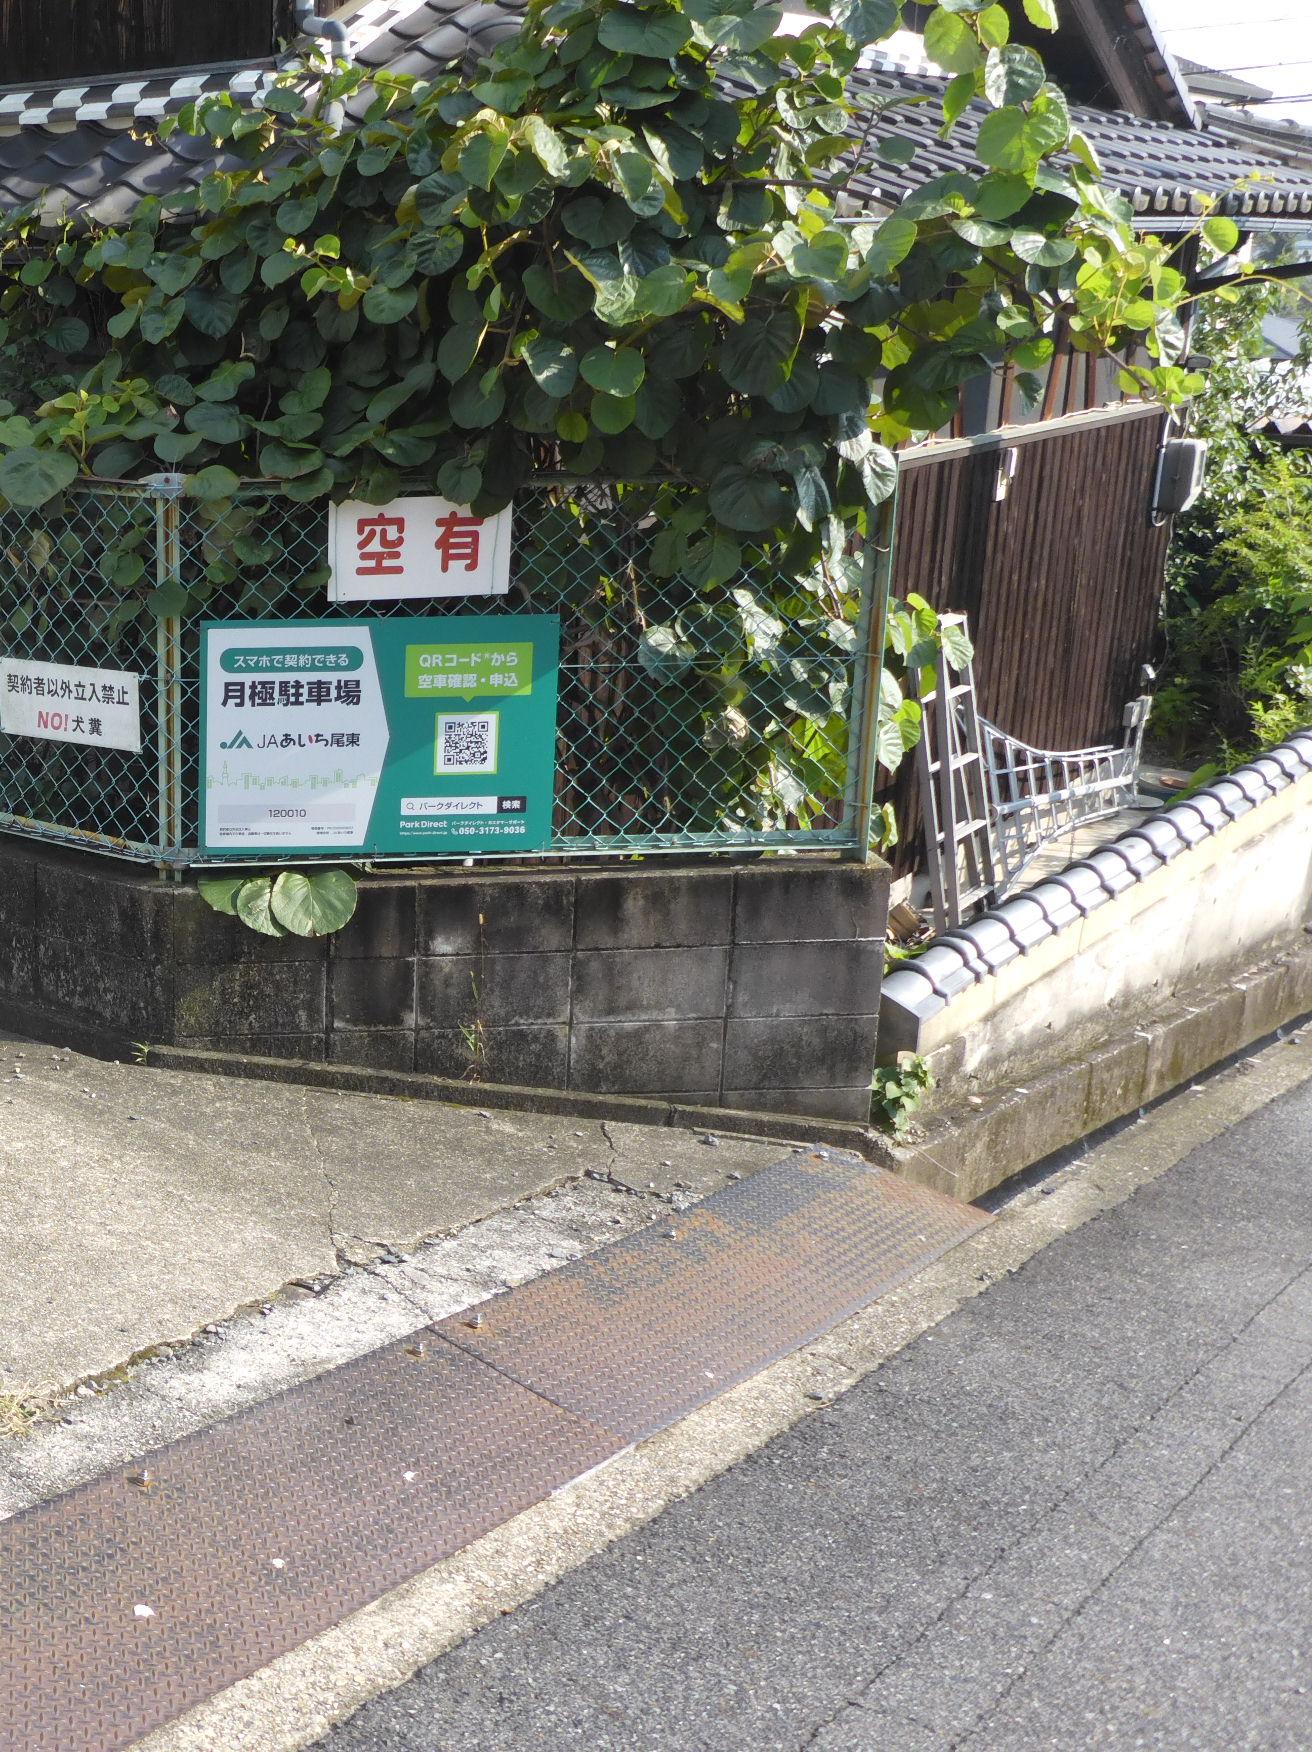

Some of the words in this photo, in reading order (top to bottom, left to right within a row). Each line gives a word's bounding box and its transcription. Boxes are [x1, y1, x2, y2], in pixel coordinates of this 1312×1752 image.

[233, 654, 349, 668] スマホで契約できる
[417, 673, 519, 689] 空車確認・申込
[6, 673, 130, 706] 契約者以外立入禁止
[221, 679, 362, 708] 月極駐車場
[257, 732, 361, 748] JAあいち尾東
[419, 801, 484, 811] パークダイレクト
[501, 800, 521, 810] 検索
[268, 809, 307, 818] 120010
[458, 826, 526, 835] 050-3173-9036
